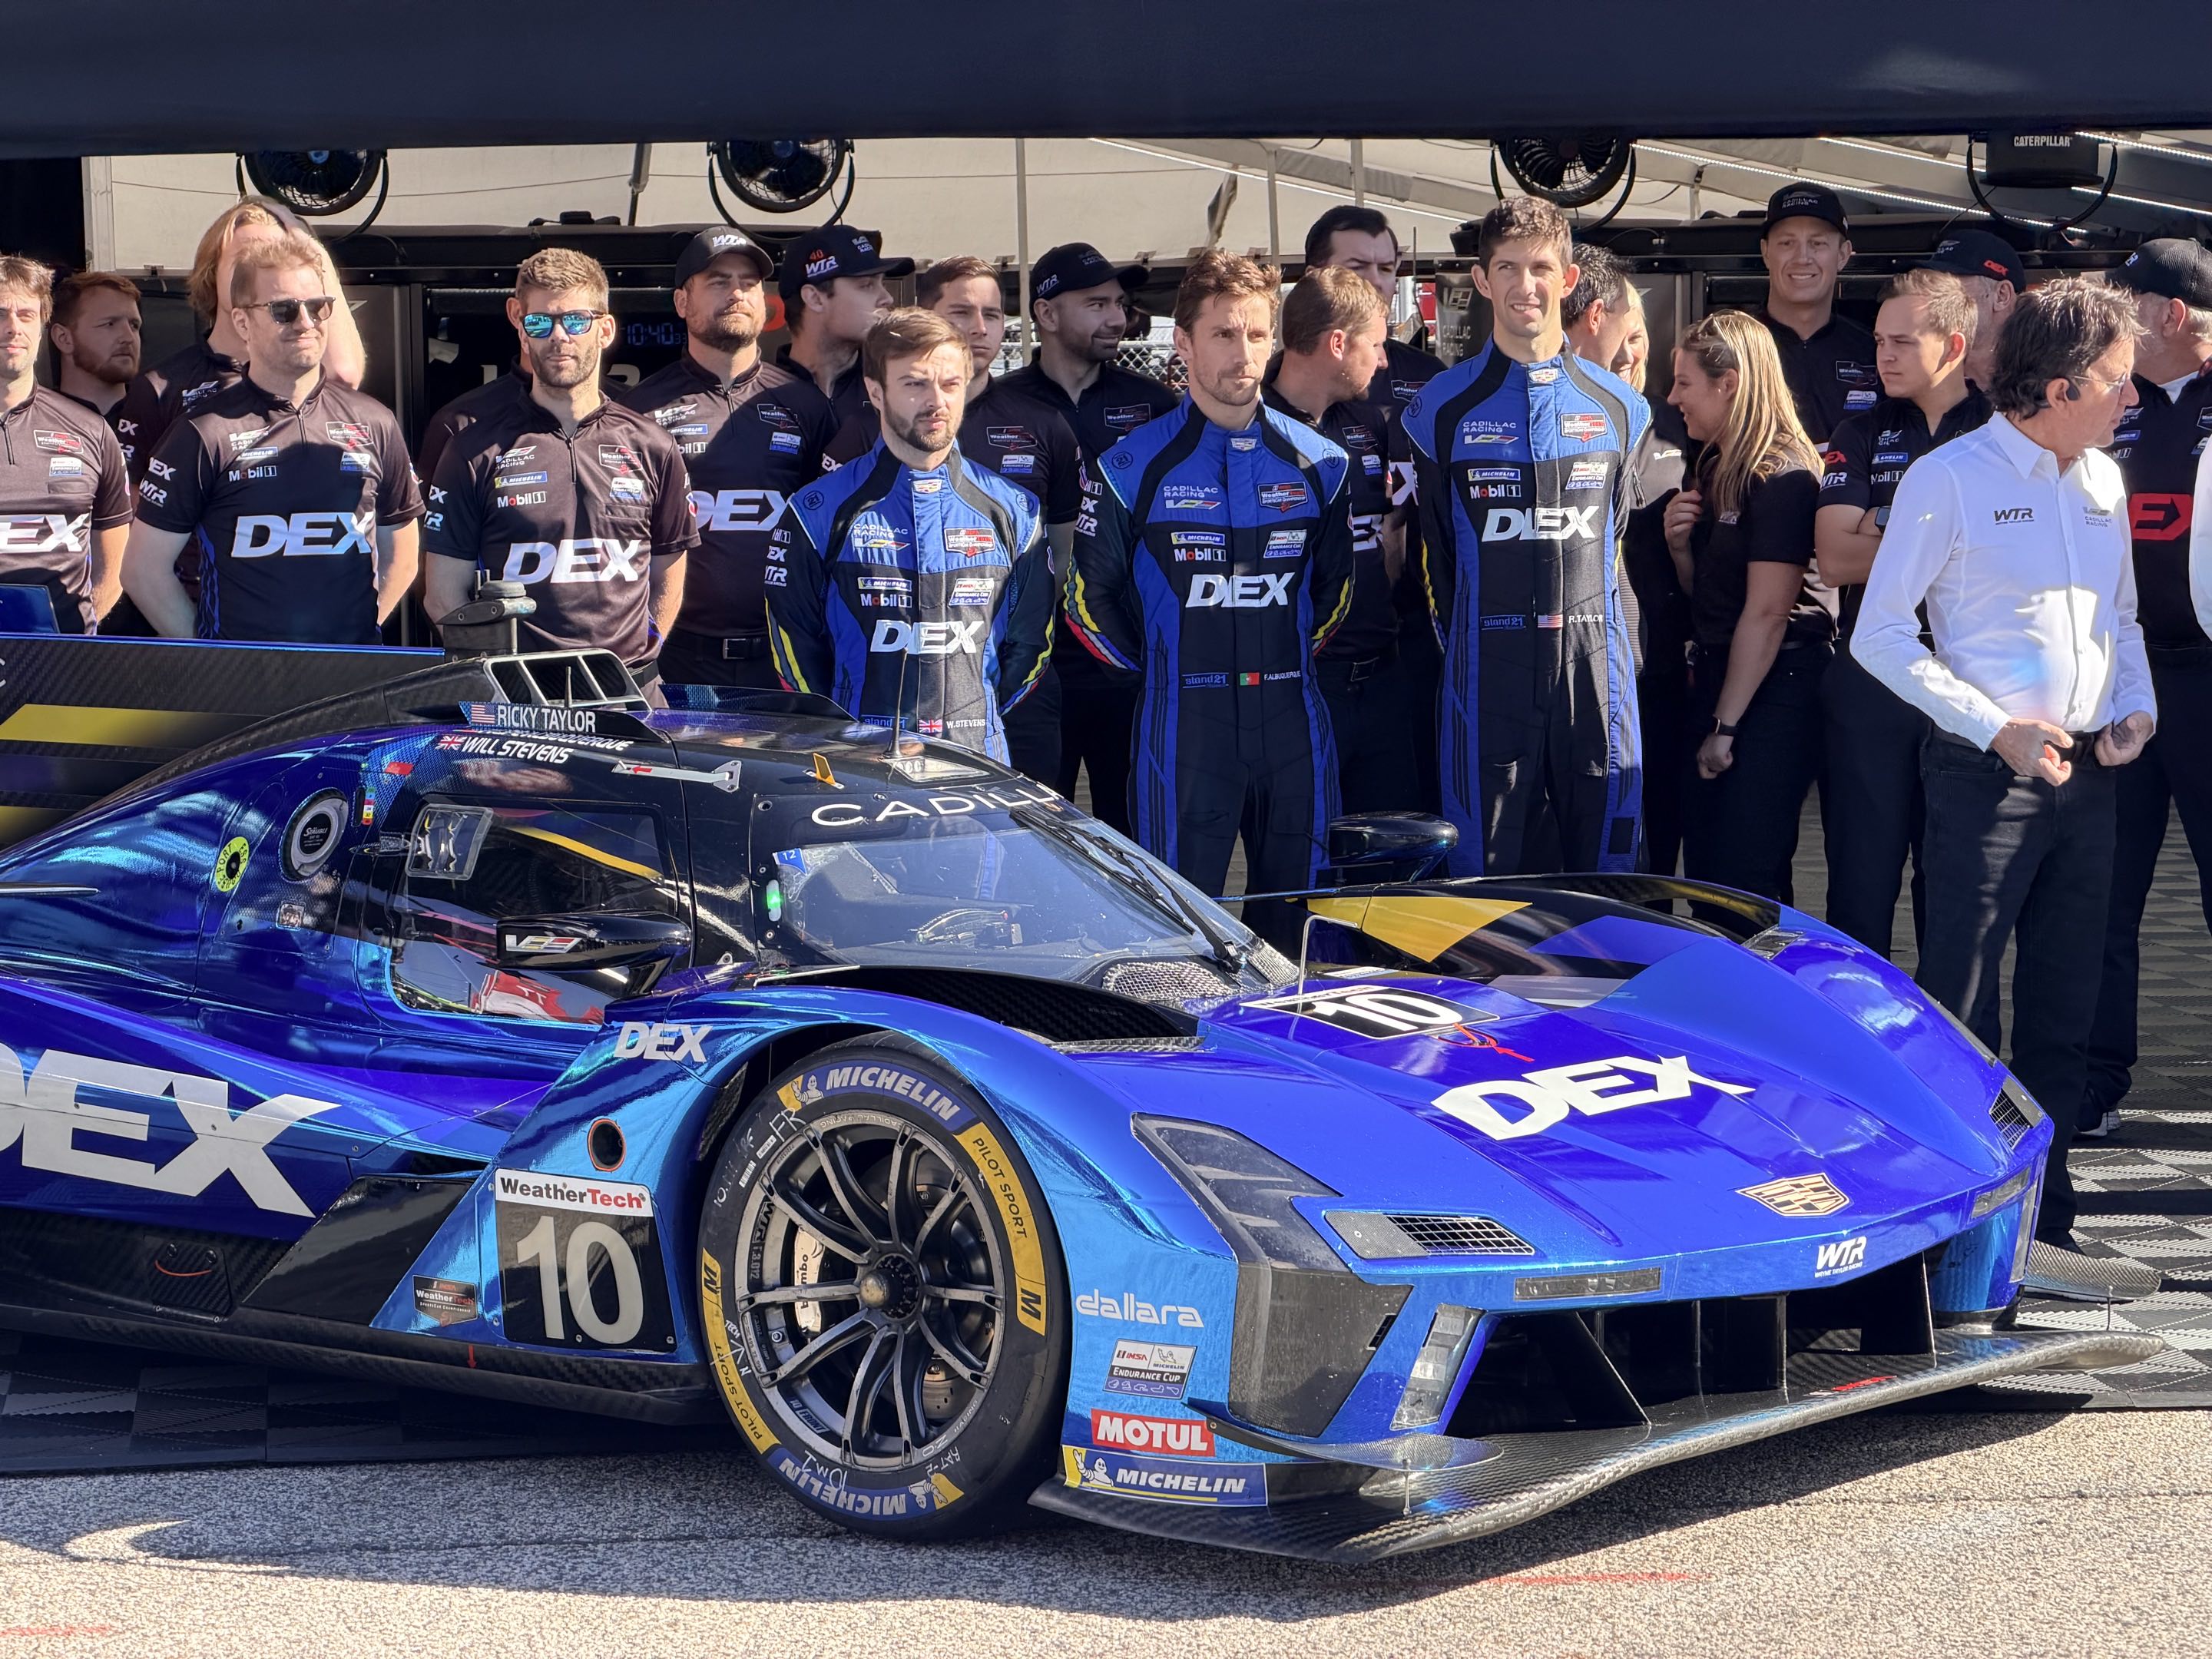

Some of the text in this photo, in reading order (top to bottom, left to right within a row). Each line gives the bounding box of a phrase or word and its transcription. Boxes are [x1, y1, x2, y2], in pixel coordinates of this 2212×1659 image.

[2014, 135, 2071, 147] CATERPILLAR
[806, 255, 837, 274] WTR
[810, 249, 824, 260] 40
[1036, 273, 1058, 294] WTR
[1462, 421, 1517, 429] CADILLAC
[677, 443, 692, 455] bil
[228, 467, 263, 482] Mobil
[508, 475, 542, 483] MICHELIN
[140, 478, 167, 504] WTR
[497, 493, 532, 508] Mobil
[1163, 485, 1219, 494] CADILLAC
[1469, 484, 1505, 499] Mobil
[1481, 506, 1600, 542] DEX
[1994, 507, 2034, 522] WTR
[0, 512, 90, 552] EX
[231, 512, 375, 558] DEX
[853, 523, 909, 535] CADILLAC
[854, 529, 895, 538] RACING
[503, 539, 642, 584] DEX
[767, 546, 787, 562] EX
[1174, 548, 1211, 561] Mobil
[859, 594, 897, 607] Mobil
[1185, 572, 1296, 608] DEX
[1568, 614, 1604, 624] R.TAYLOR
[870, 619, 985, 655] DEX
[498, 704, 597, 733] RICKY TAYLOR
[945, 718, 986, 730] W.STEVENS
[462, 736, 575, 764] WILL STEVENS
[782, 849, 796, 861] 12
[1313, 993, 1463, 1031] 10
[614, 1021, 714, 1063] DEX
[825, 1066, 962, 1122] MICHELIN
[1430, 1055, 1756, 1141] DEX
[500, 1177, 644, 1210] WeatherTech
[972, 1137, 1028, 1239] PILOT SPORT
[1816, 1236, 1867, 1270] WTR
[516, 1214, 644, 1345] 10
[800, 1253, 809, 1310] bmbo
[1814, 1270, 1832, 1279] WAYNE
[1832, 1266, 1849, 1276] TAYLOR
[416, 1289, 475, 1306] WeatherTech
[1020, 1286, 1042, 1321] M
[1076, 1289, 1204, 1328] dallara
[1126, 1351, 1148, 1361] IMSA
[1162, 1373, 1181, 1382] CUP
[714, 1342, 763, 1440] SPORT PILOT
[1097, 1416, 1208, 1451] MOTUL
[779, 1457, 906, 1515] MICHELIN
[1116, 1468, 1247, 1493] MICHELIN
